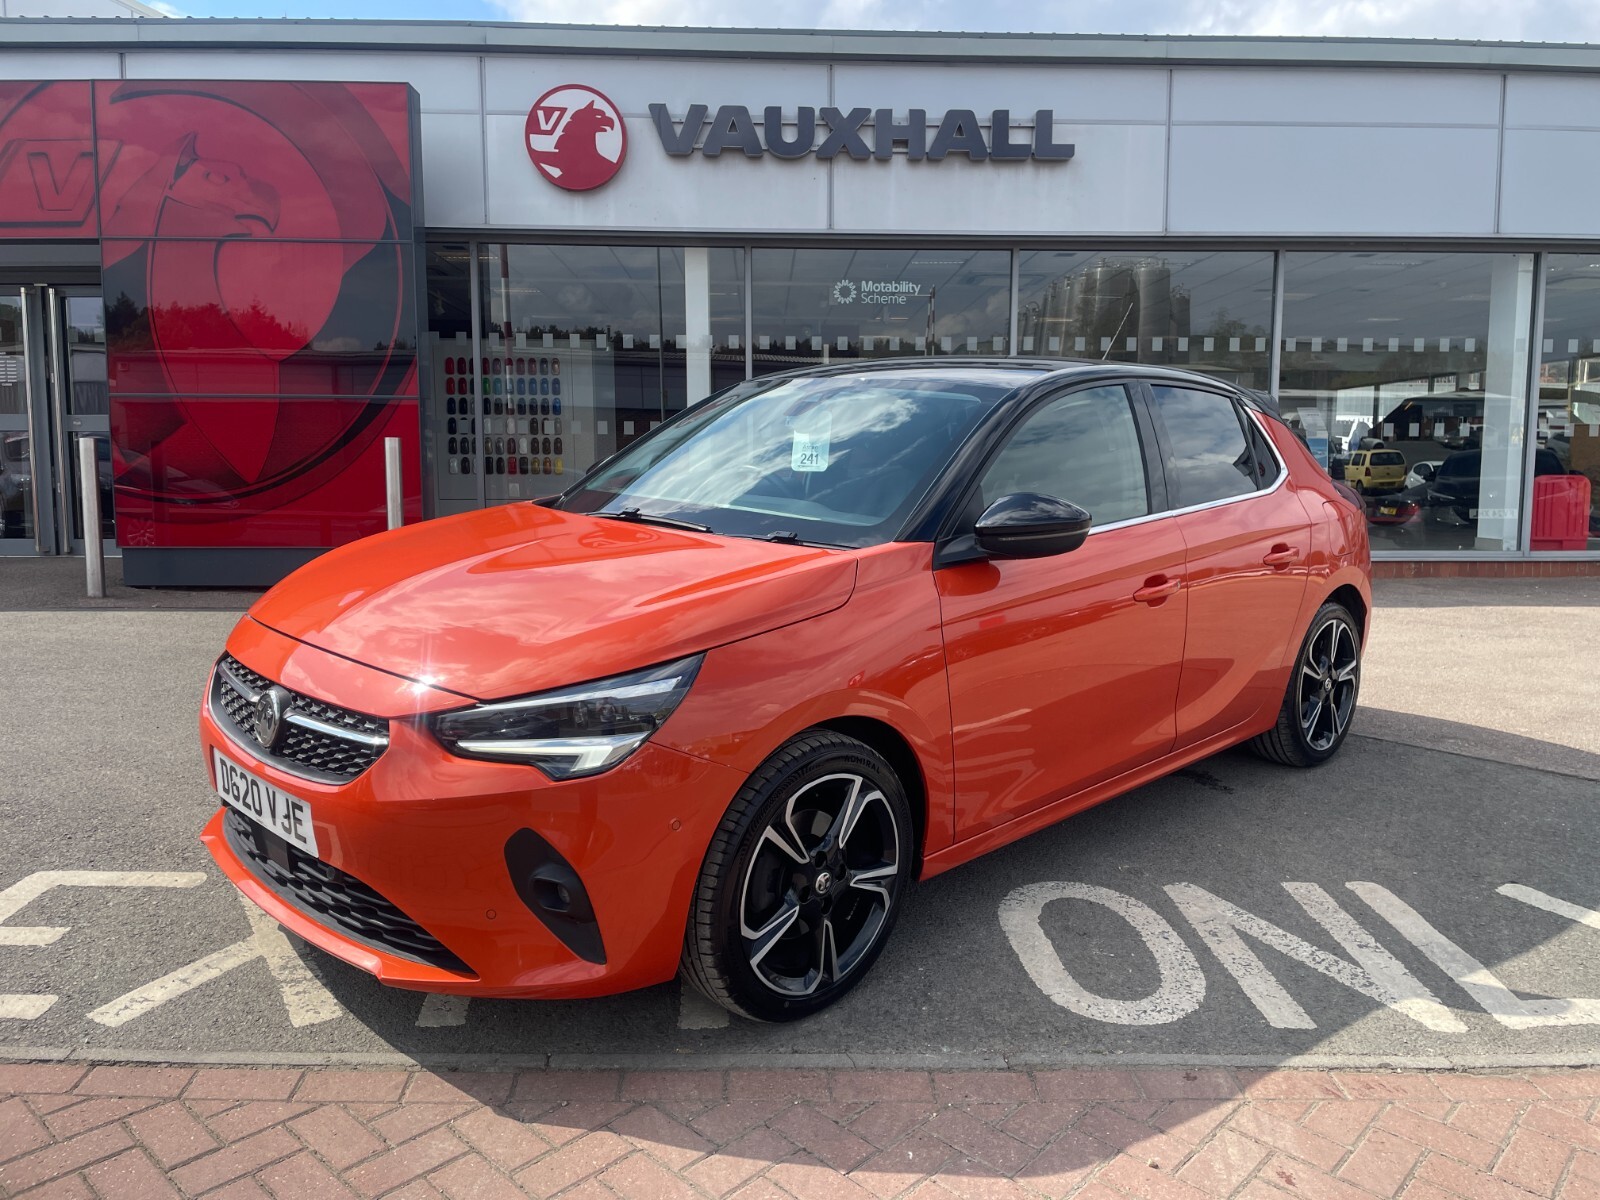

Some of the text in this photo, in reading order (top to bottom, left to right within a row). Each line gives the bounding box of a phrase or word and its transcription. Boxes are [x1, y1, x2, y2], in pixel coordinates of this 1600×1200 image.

[648, 103, 1075, 162] VAUXHALL
[861, 281, 921, 296] Motability
[861, 292, 907, 305] Scheme
[800, 453, 819, 465] 241
[265, 786, 307, 845] VJE
[998, 881, 1600, 1033] ONL
